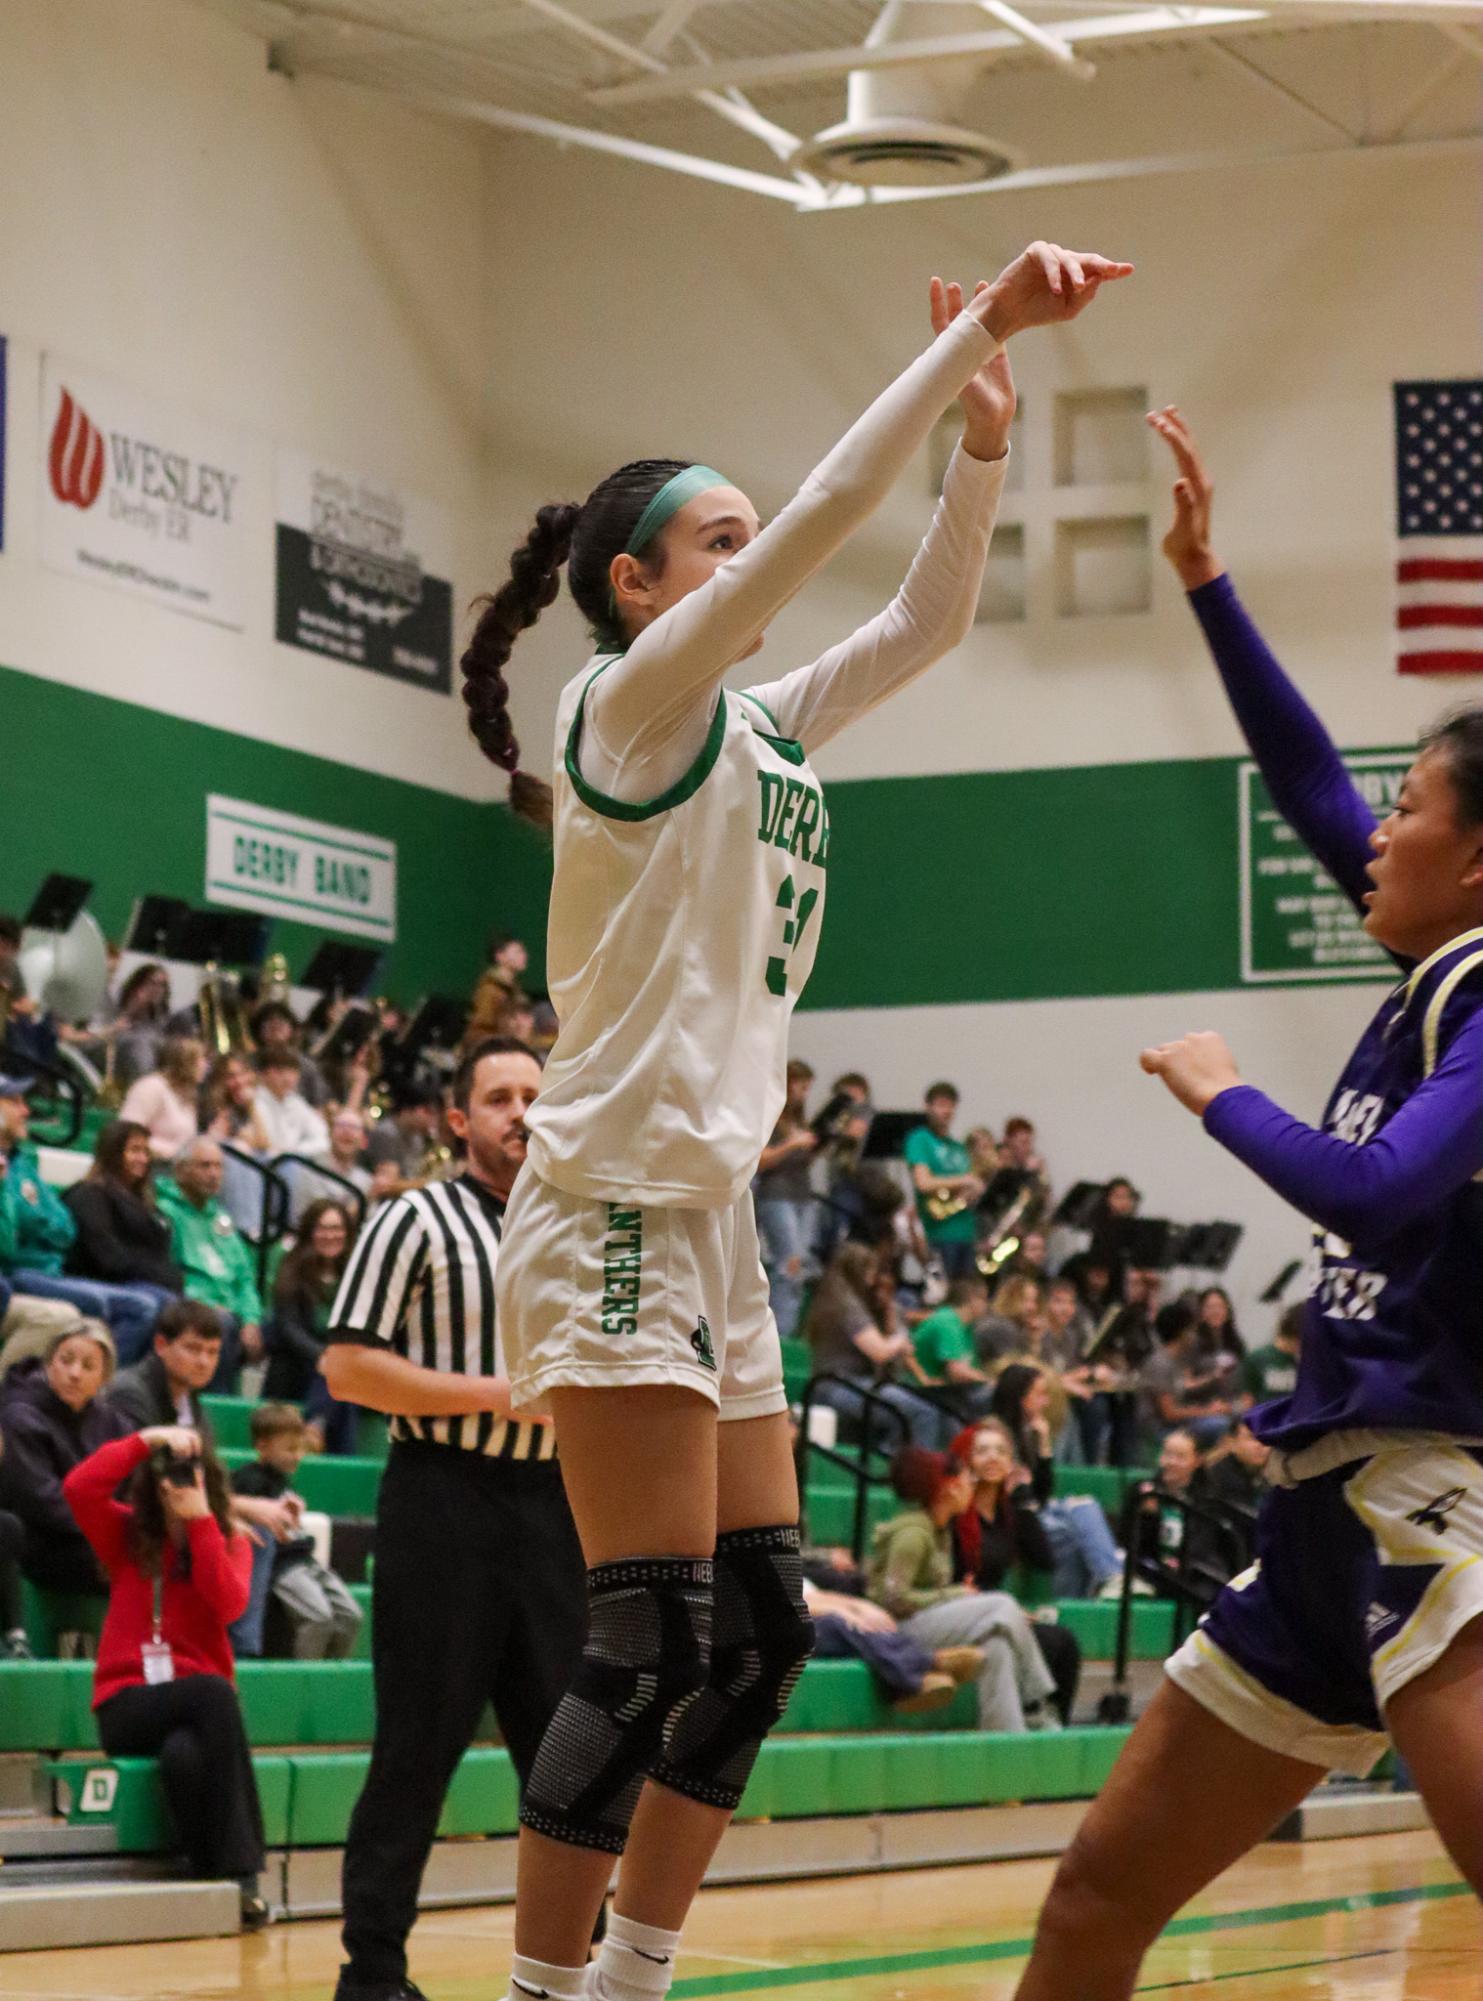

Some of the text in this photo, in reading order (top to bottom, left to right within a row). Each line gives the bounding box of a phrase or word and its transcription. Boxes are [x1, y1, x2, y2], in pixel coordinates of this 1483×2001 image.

[110, 430, 238, 524] WESLEY
[234, 834, 370, 905] DERBY BAND
[601, 1202, 642, 1335] NTHERS
[92, 1778, 109, 1800] D
